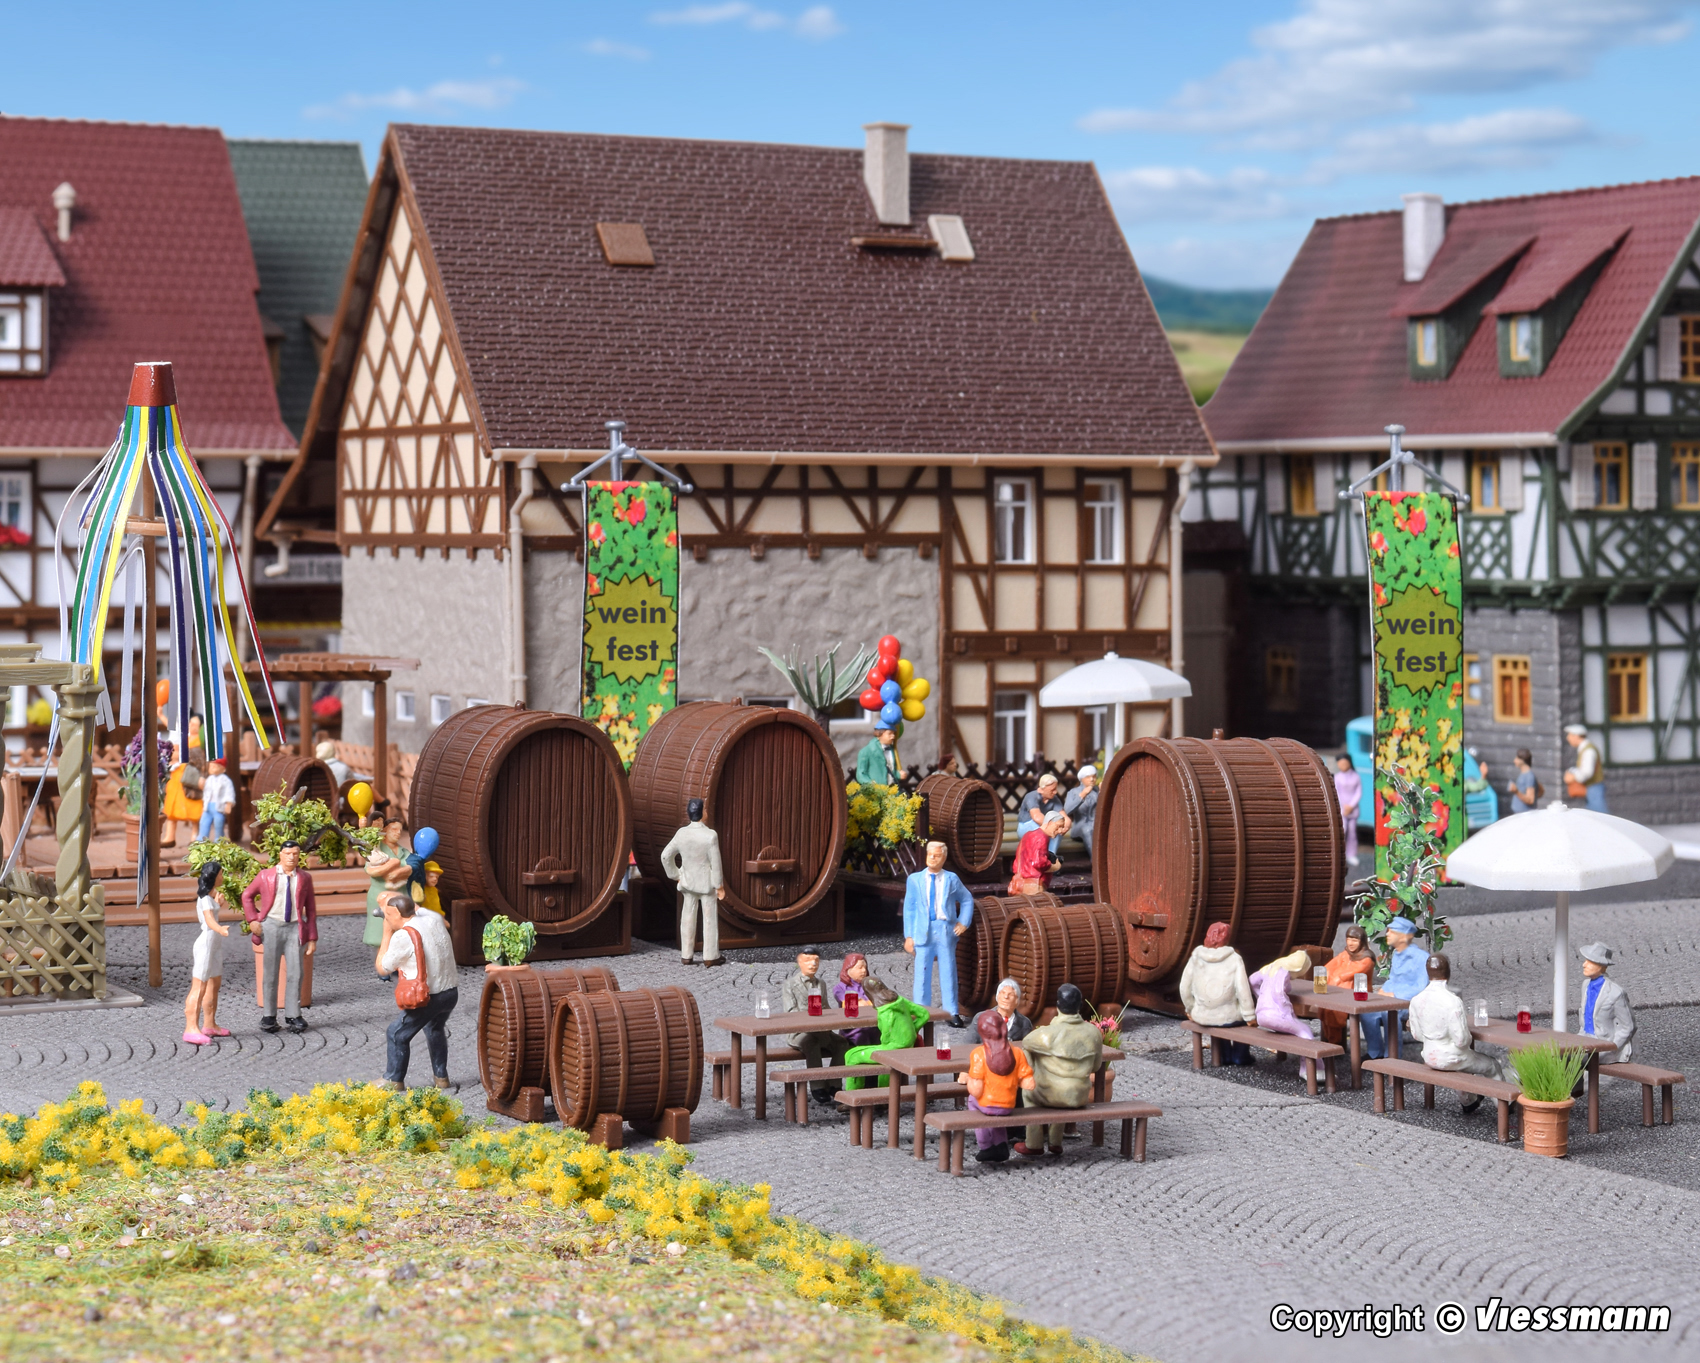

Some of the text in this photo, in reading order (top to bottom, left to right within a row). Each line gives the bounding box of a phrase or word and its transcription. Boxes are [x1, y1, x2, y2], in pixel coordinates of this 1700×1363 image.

[597, 599, 666, 624] wein
[1385, 611, 1455, 635] wein
[606, 636, 659, 661] fest
[1394, 647, 1448, 672] fest
